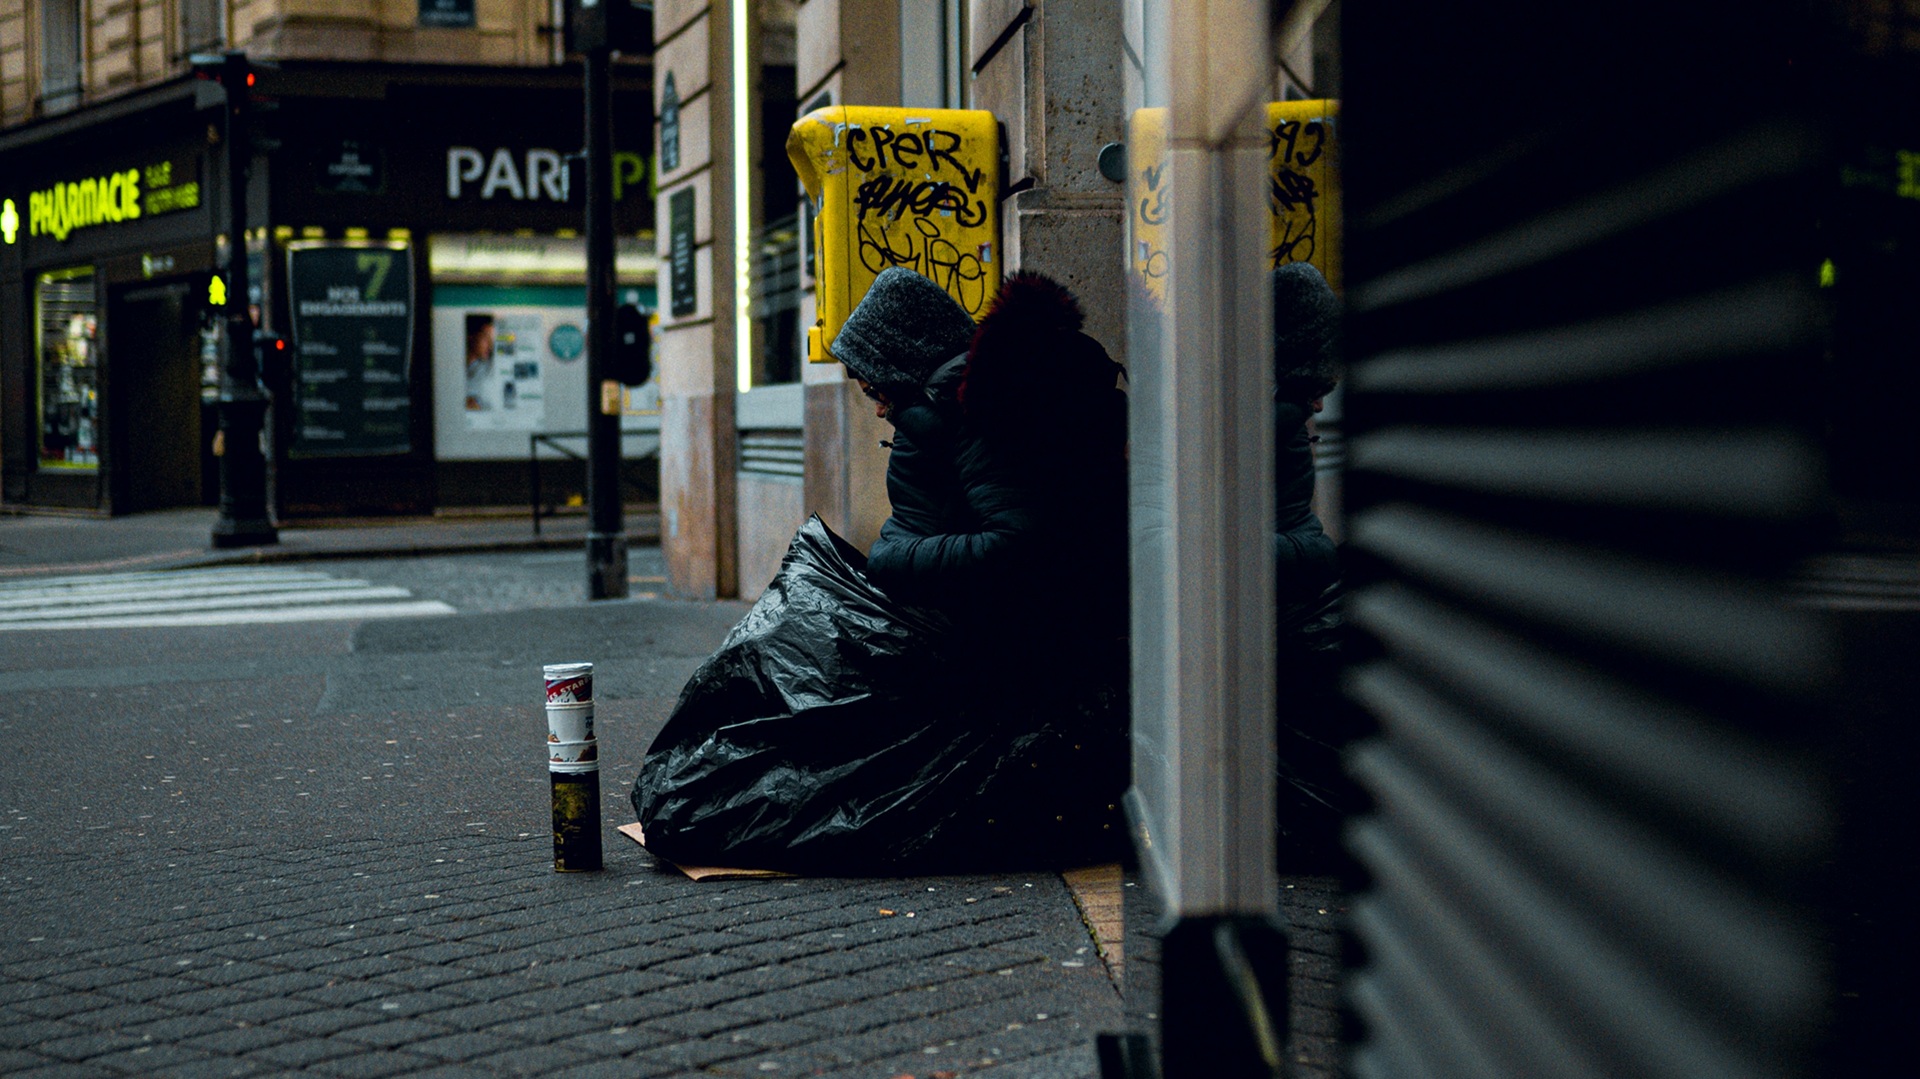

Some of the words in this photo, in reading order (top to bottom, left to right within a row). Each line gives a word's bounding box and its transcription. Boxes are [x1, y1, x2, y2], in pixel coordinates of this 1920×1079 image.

[446, 146, 563, 201] PAR
[29, 167, 141, 241] PHARMACIE
[357, 252, 392, 300] 7
